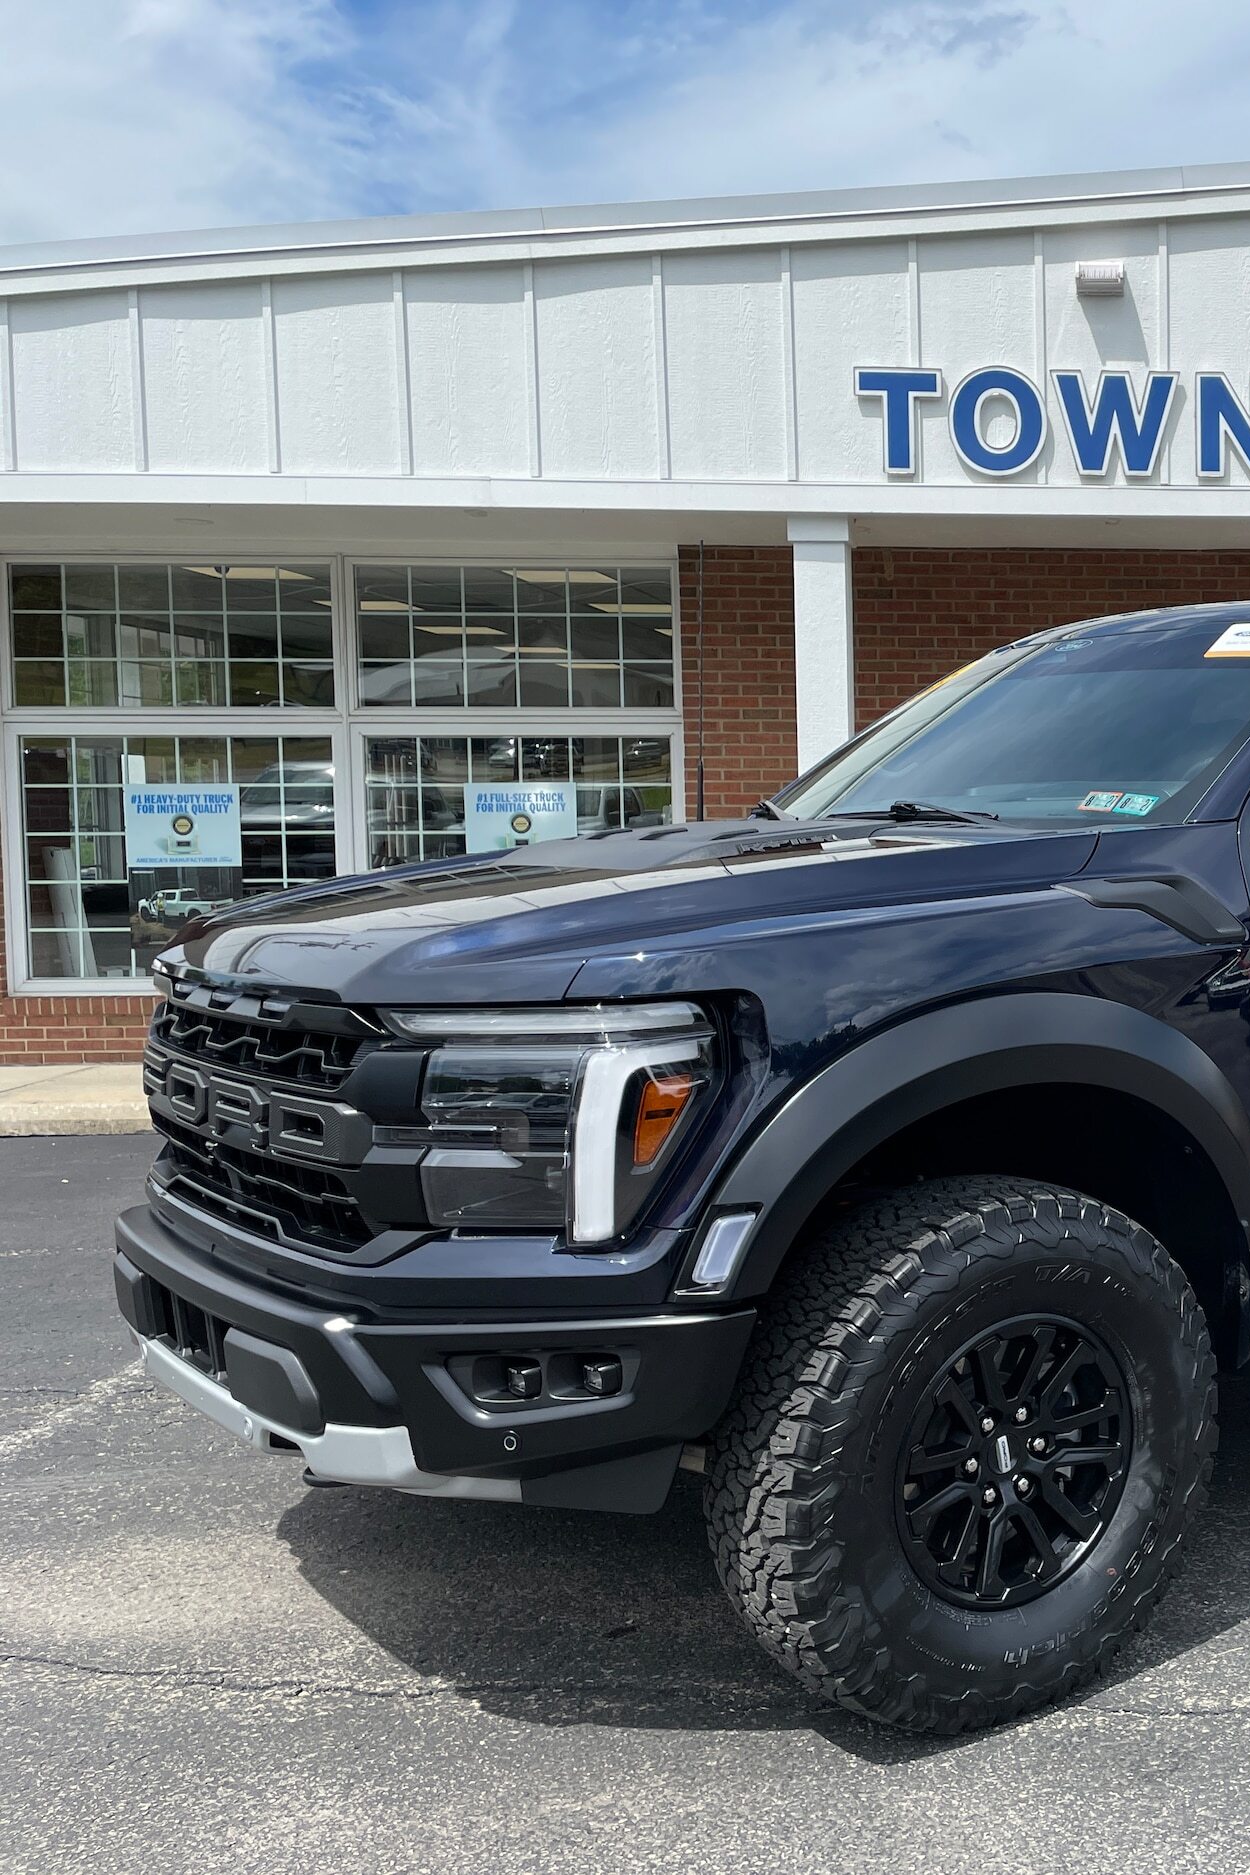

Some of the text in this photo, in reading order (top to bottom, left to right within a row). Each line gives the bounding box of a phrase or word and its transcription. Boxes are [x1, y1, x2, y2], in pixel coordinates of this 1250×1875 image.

[131, 794, 233, 804] #1 HEAVY-DUTY TRUCK
[477, 793, 564, 802] #1 FULL-SIZE TRUCK
[137, 804, 229, 815] FOR INITIAL QUALITY
[476, 803, 566, 814] FOR INITIAL QUALITY
[143, 1047, 360, 1164] FORD
